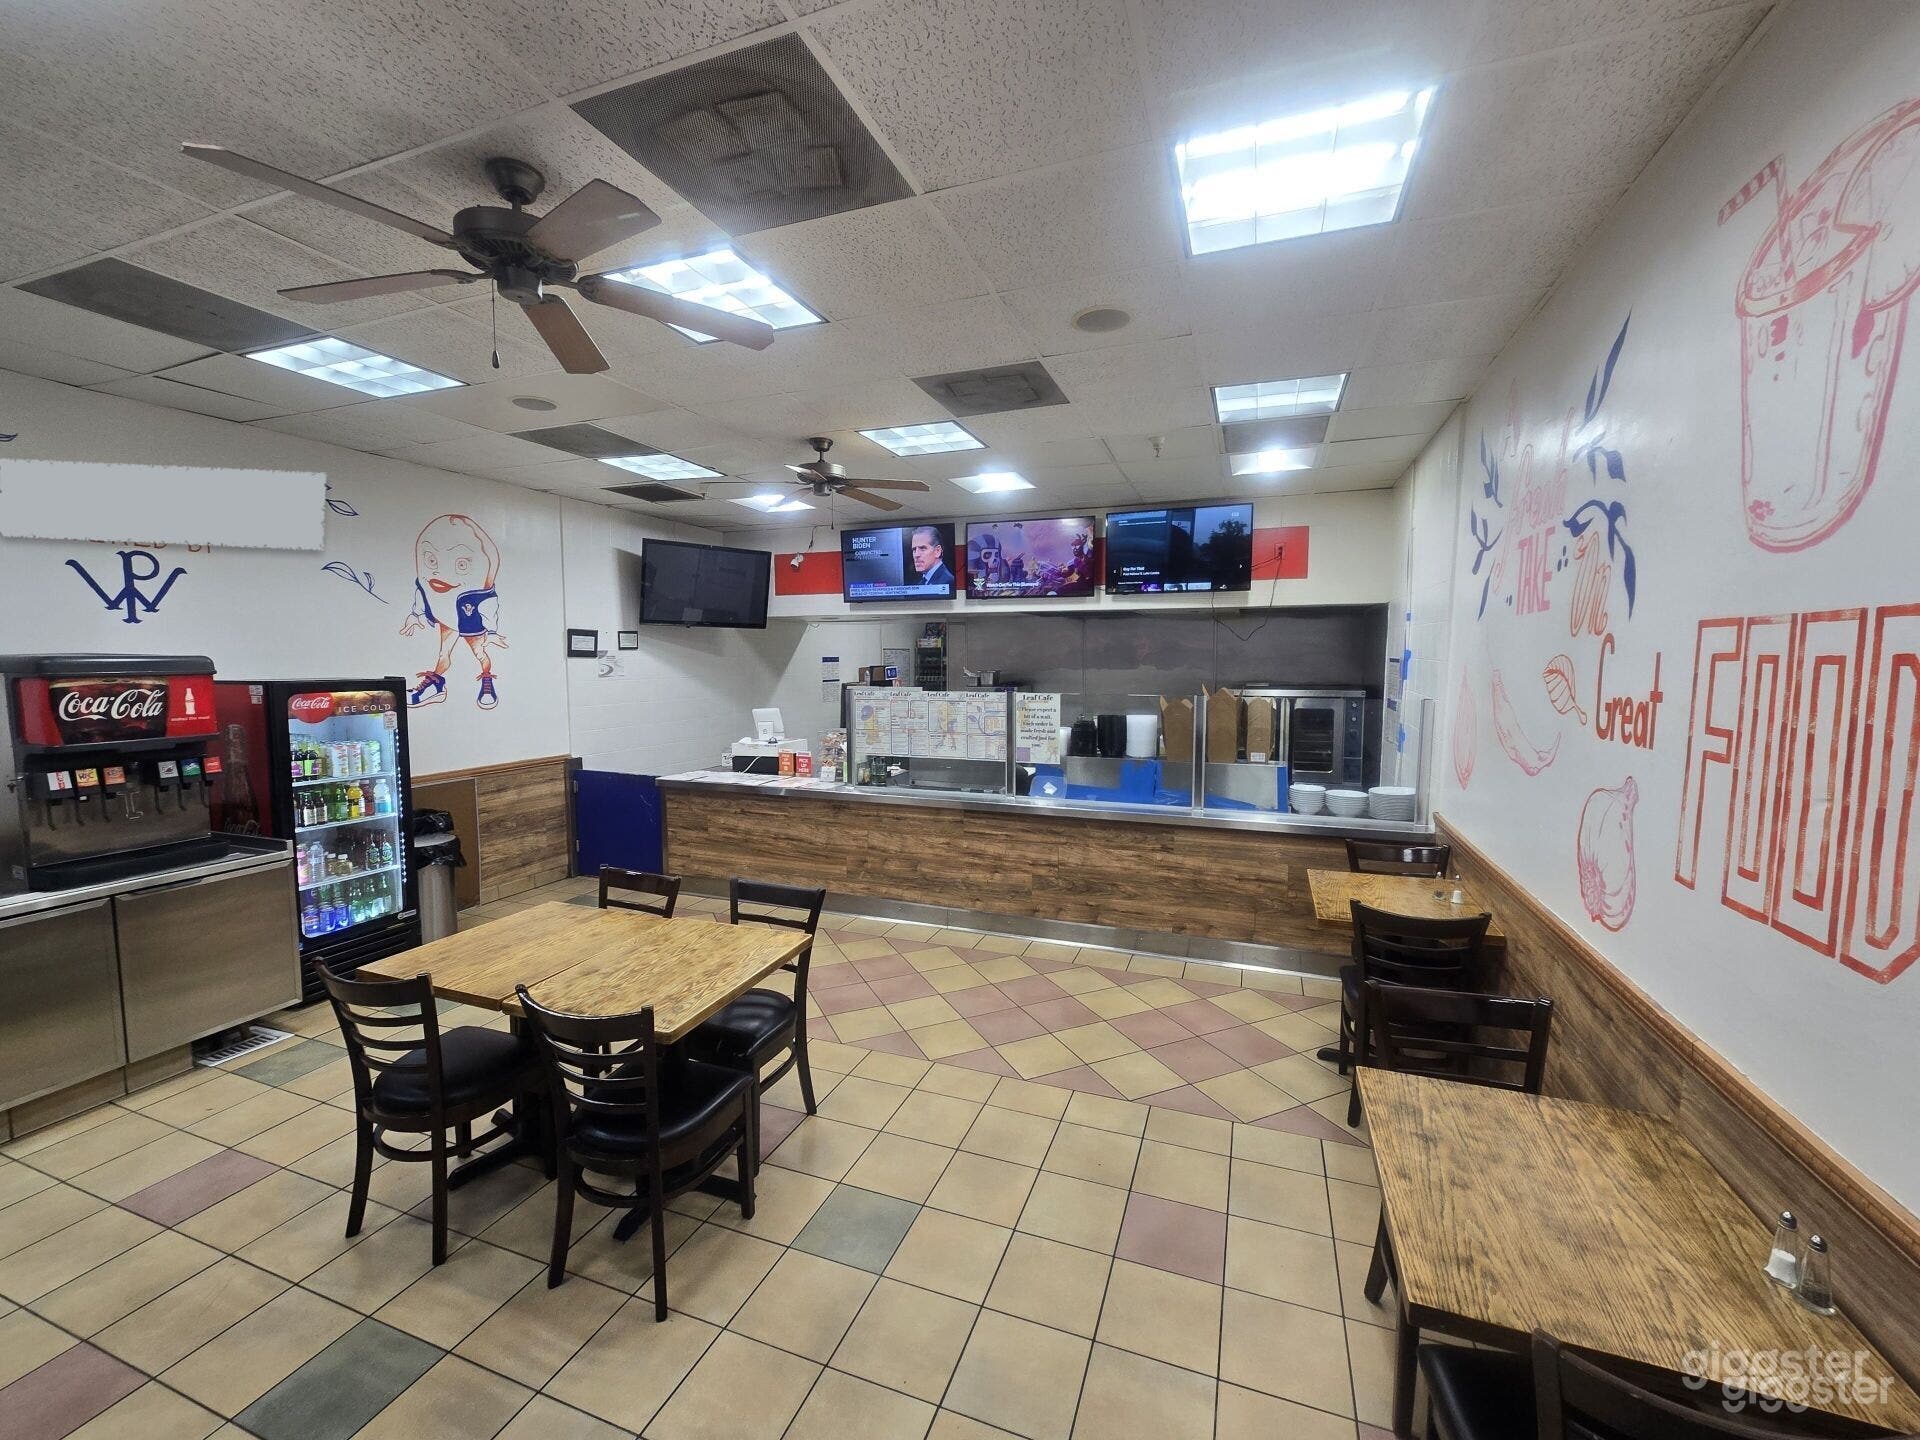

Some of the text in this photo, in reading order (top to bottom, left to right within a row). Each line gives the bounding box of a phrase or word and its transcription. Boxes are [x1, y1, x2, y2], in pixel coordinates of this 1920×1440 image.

[852, 536, 876, 544] HUNTER
[1515, 526, 1556, 616] TAKE
[58, 688, 166, 721] Coca-Cola
[292, 696, 331, 710] Coca-Cola
[338, 703, 391, 713] ICE COLD
[1595, 634, 1664, 751] Great
[1674, 603, 1920, 985] FOOD
